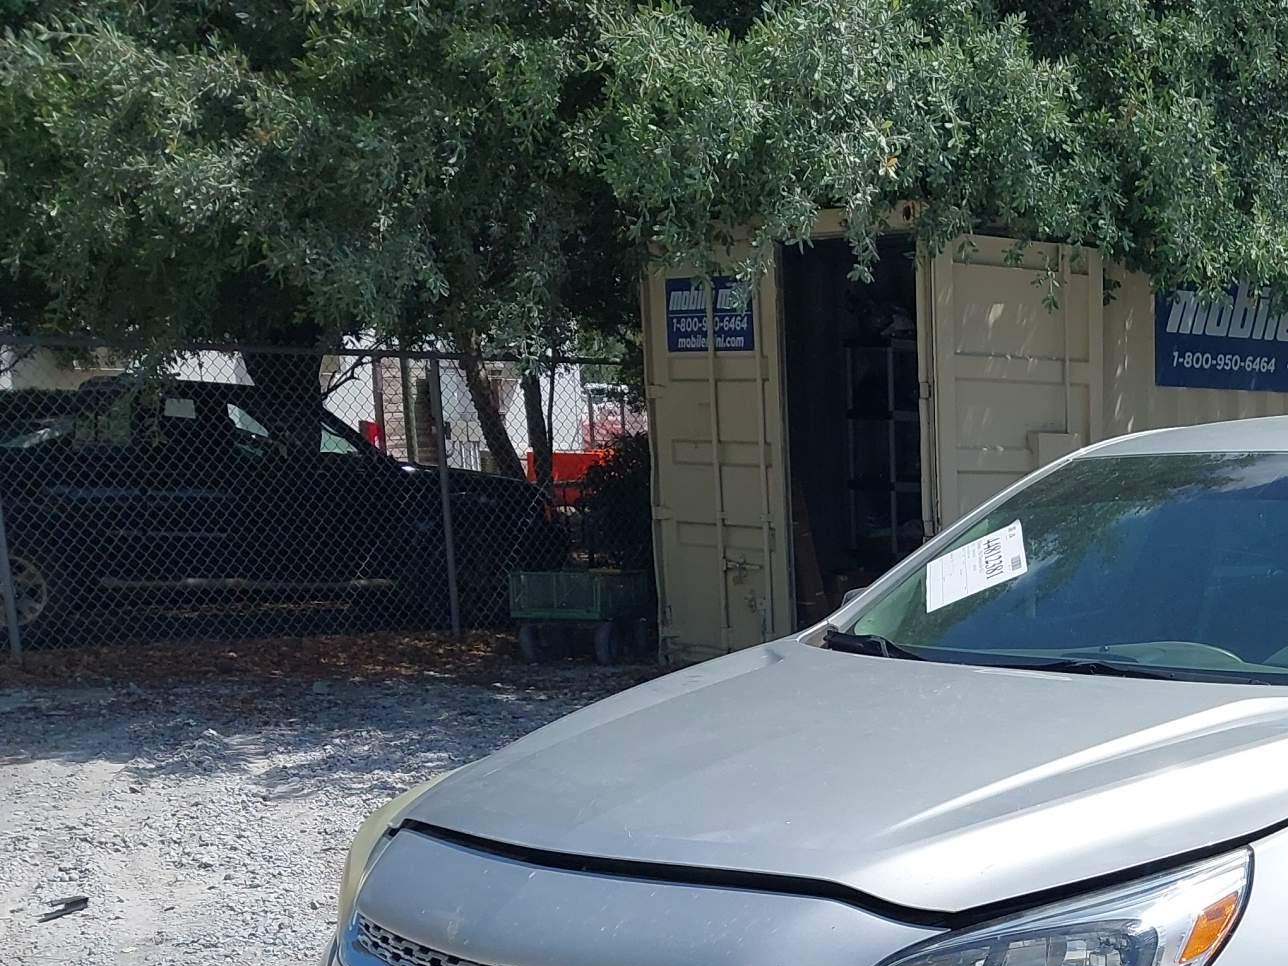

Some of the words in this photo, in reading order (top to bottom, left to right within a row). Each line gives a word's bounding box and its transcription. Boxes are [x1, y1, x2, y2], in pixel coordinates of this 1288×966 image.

[669, 285, 708, 311] mobil
[672, 316, 748, 333] 1-800-90-6464
[677, 334, 744, 348] mobileini.com
[1172, 351, 1276, 373] 1-800-950-6464
[983, 537, 1004, 580] 44812381
